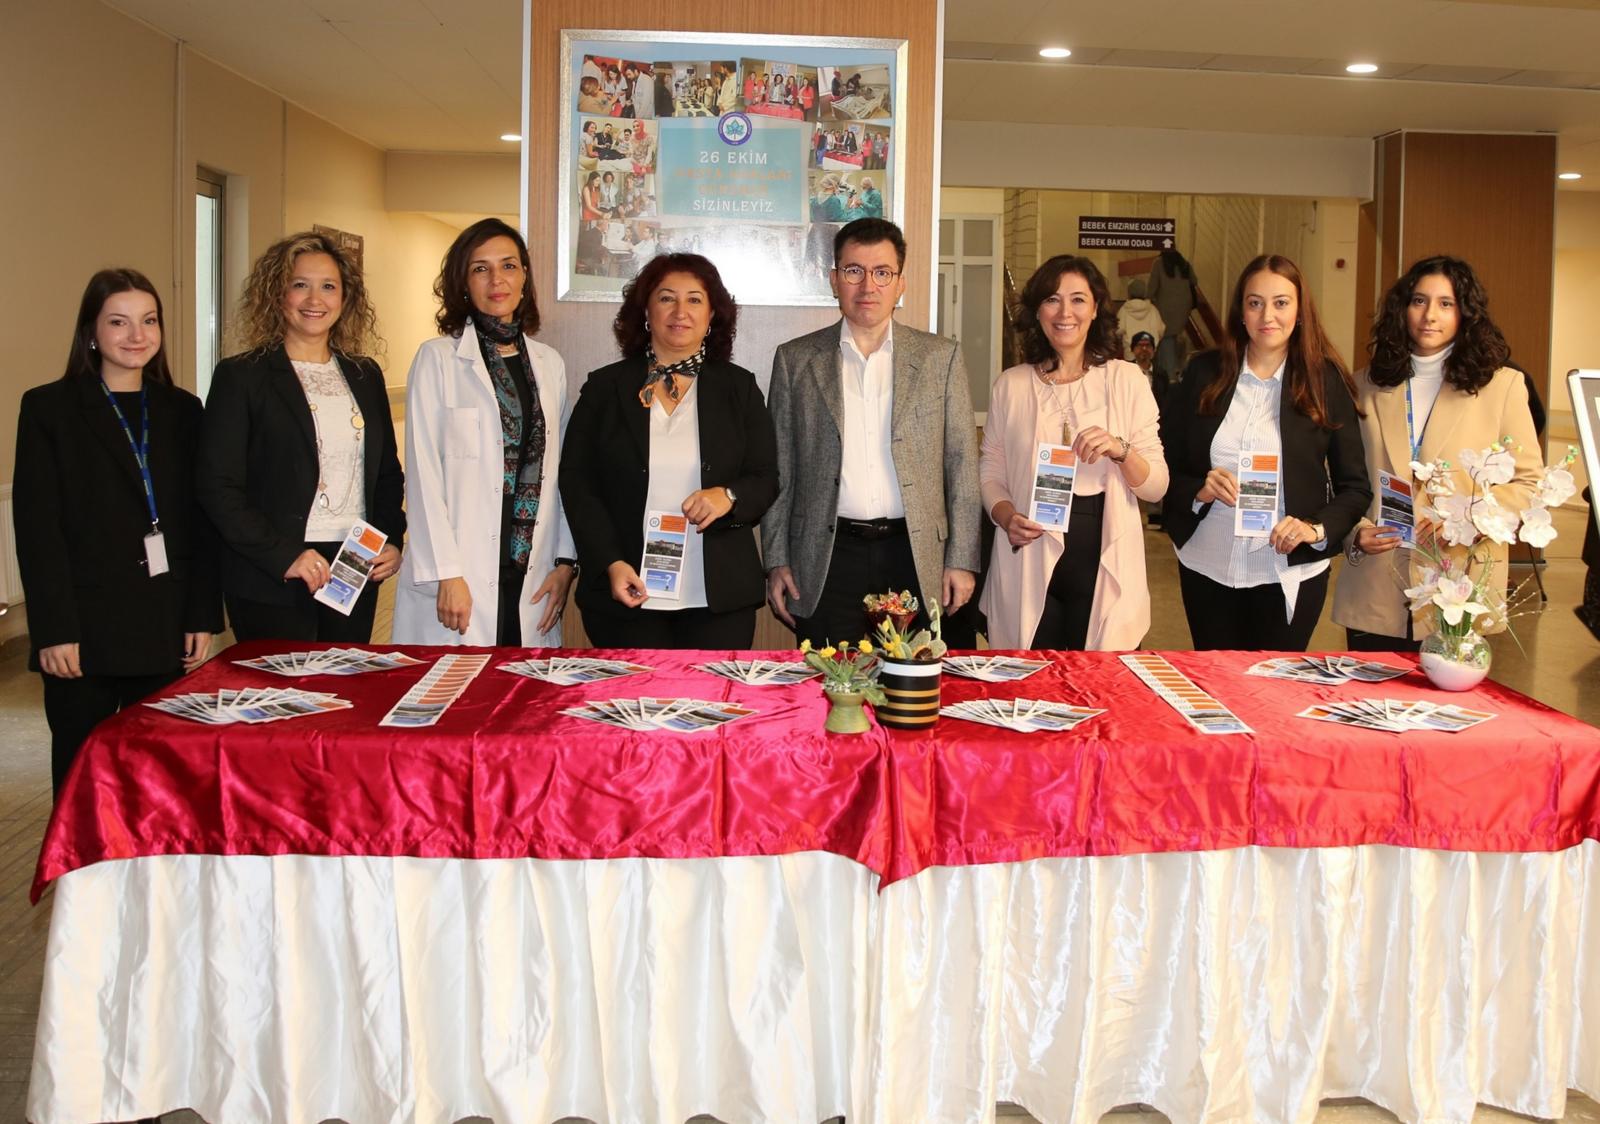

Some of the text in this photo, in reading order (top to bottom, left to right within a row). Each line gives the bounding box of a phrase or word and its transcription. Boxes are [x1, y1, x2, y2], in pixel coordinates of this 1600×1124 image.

[700, 150, 768, 165] 26 EKİM
[692, 197, 775, 213] SİZİNLEYİZ
[1081, 221, 1107, 230] BEBEK
[1140, 223, 1163, 232] ODASI
[1081, 238, 1153, 248] BEBEK BAKIM ODASI
